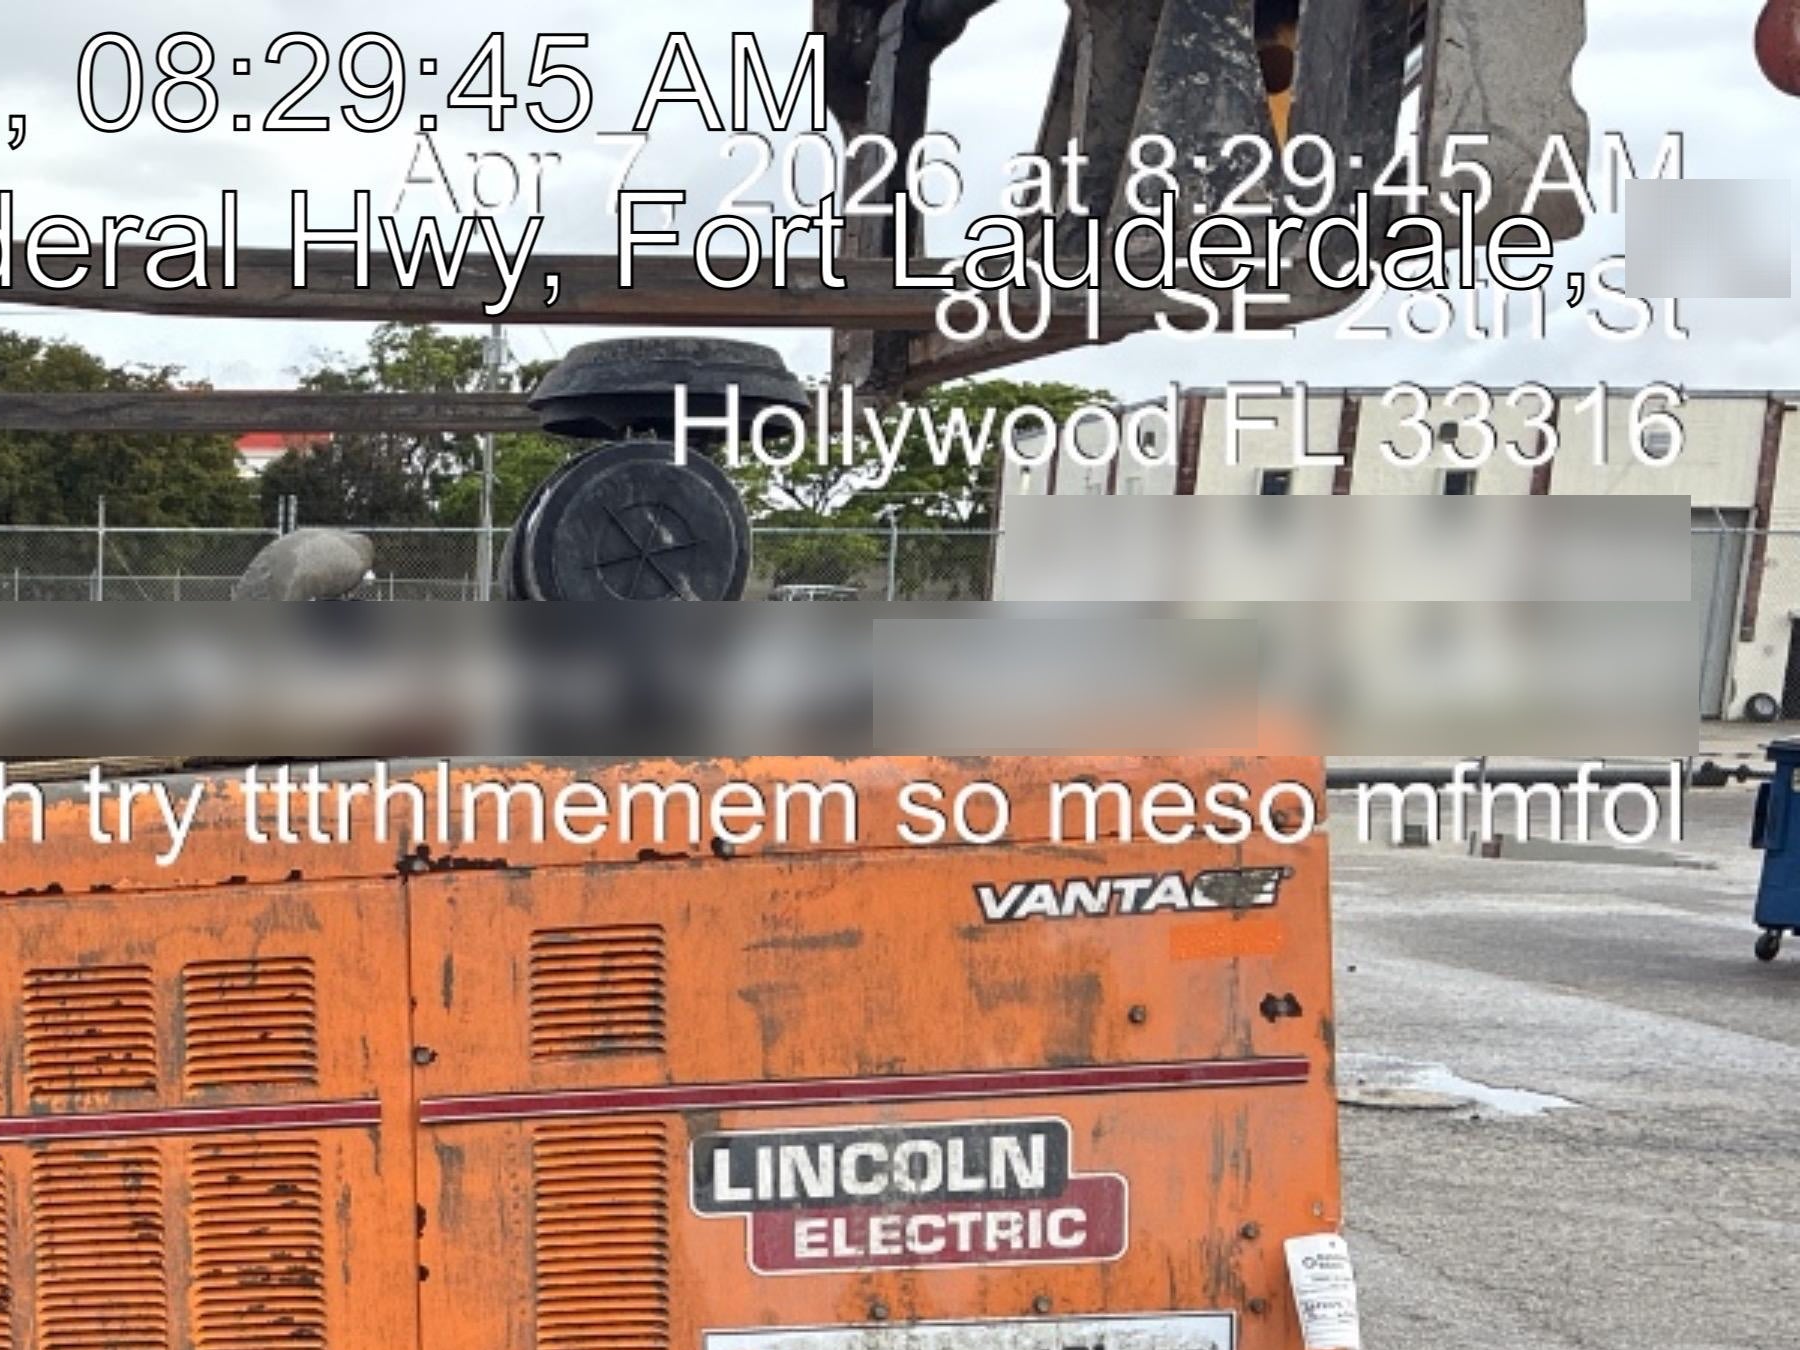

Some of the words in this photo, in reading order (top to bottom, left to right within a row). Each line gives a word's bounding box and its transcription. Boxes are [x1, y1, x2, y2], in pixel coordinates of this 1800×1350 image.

[975, 866, 1285, 922] VANTA
[712, 1133, 1047, 1202] LINCOLN
[793, 1206, 1088, 1260] ELECTRIC
